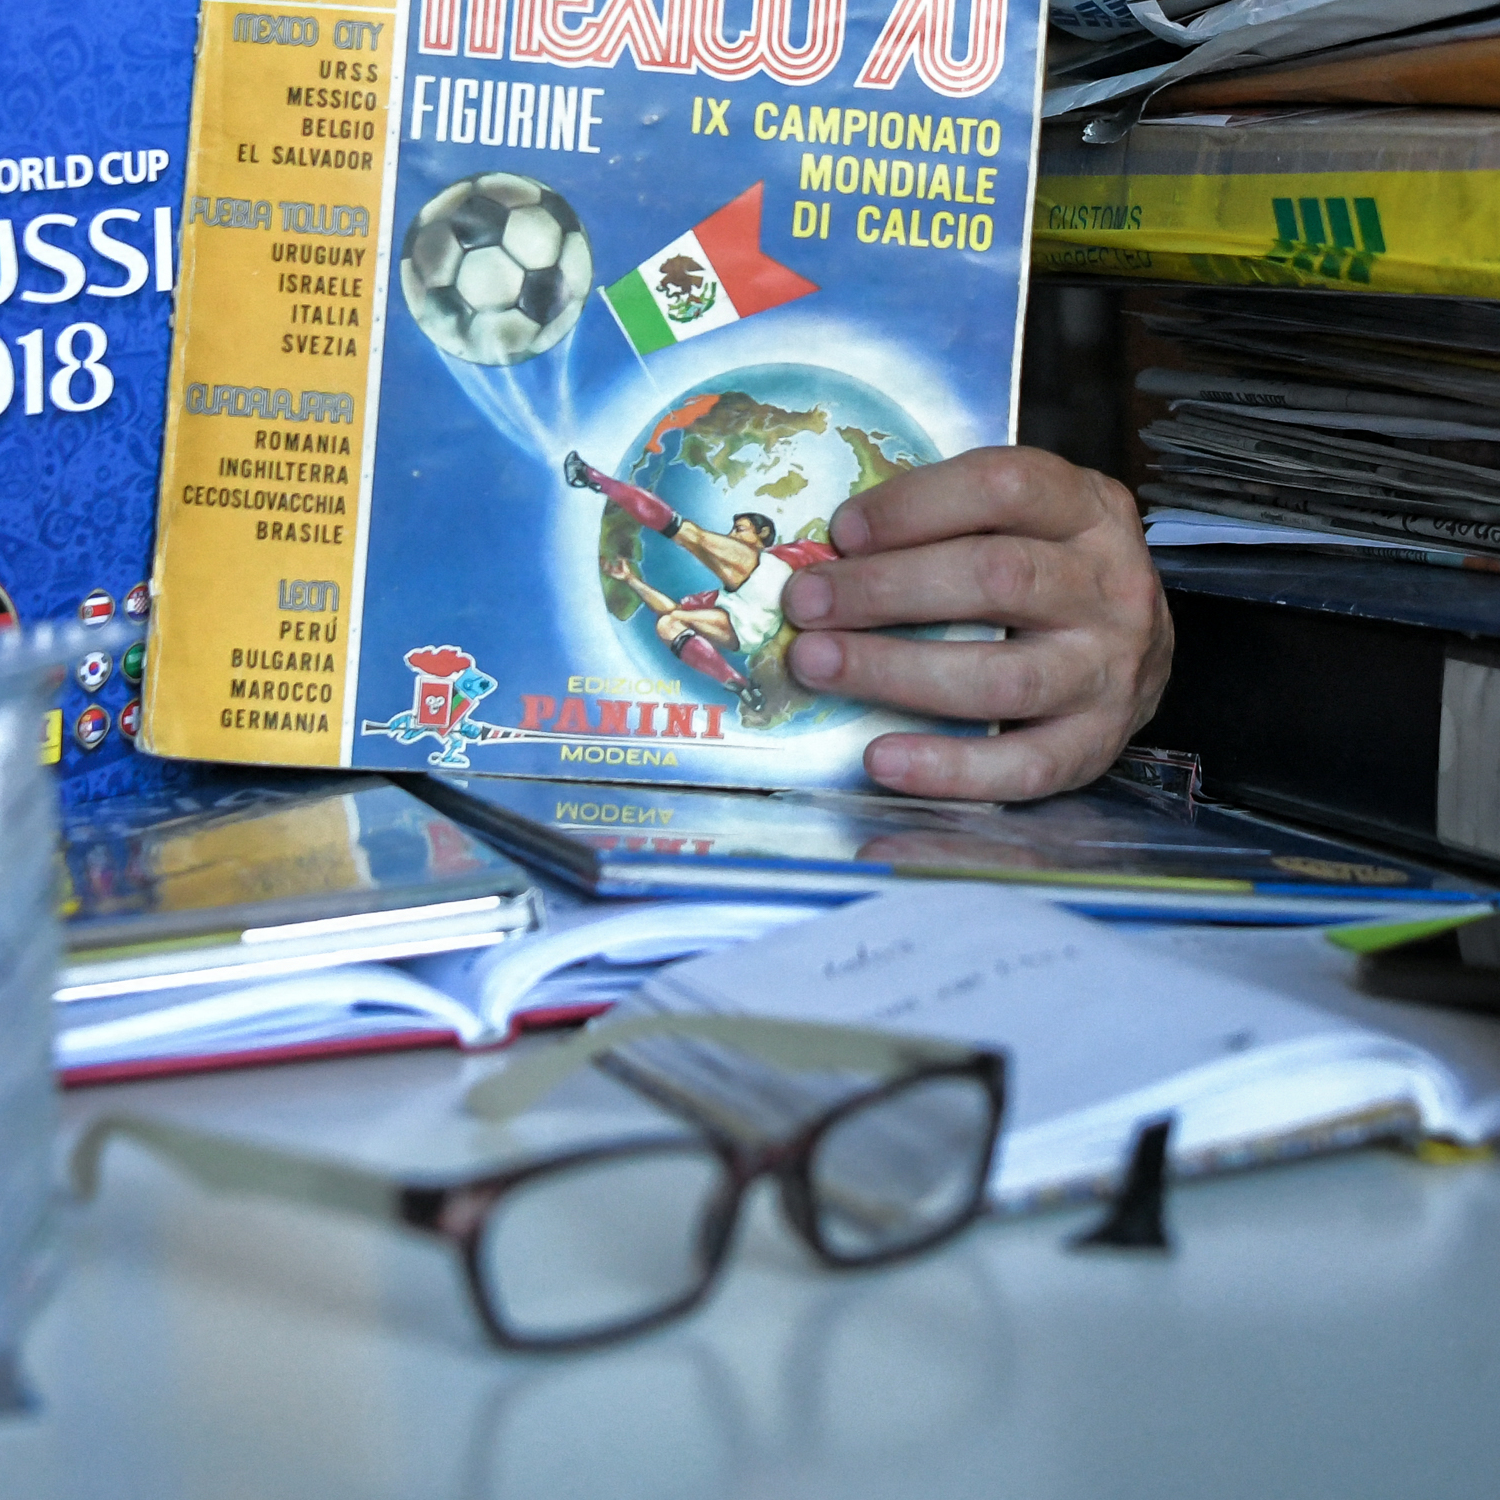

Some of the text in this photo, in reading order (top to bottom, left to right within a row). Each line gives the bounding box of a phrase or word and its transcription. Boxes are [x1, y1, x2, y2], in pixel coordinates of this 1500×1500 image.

[232, 13, 385, 51] MEXICO CITY
[319, 60, 379, 83] URSS
[286, 87, 377, 112] MESSICO
[409, 74, 605, 153] FIGURINE
[691, 96, 1002, 157] IX CAMPIONATO
[302, 117, 375, 141] BELGIO
[104, 148, 170, 187] CUP
[238, 144, 373, 172] EL SALVADOR
[800, 152, 999, 206] MONDIALE
[188, 195, 370, 238] PUEBLA TOLUCA
[791, 200, 994, 253] DI CALCIO
[271, 243, 366, 268] URUGUAY
[278, 273, 363, 298] ISRAELE
[291, 304, 359, 327] ITALIA
[281, 334, 358, 357] SVEZIA
[185, 382, 355, 424] GUADALAJARA
[255, 430, 351, 456] ROMANIA
[219, 458, 349, 484] INGHILTERRA
[182, 484, 347, 516] CECOSLOVACCHIA
[256, 521, 344, 545] BRASILE
[278, 579, 340, 612] LEON
[280, 616, 337, 643] PERÚ
[231, 648, 335, 673] BULGARIA
[230, 678, 333, 703] MAROCCO
[567, 675, 682, 696] EDIZIONI
[220, 708, 329, 733] GERMANIA
[520, 694, 727, 739] PANINI
[560, 745, 678, 767] MODENA
